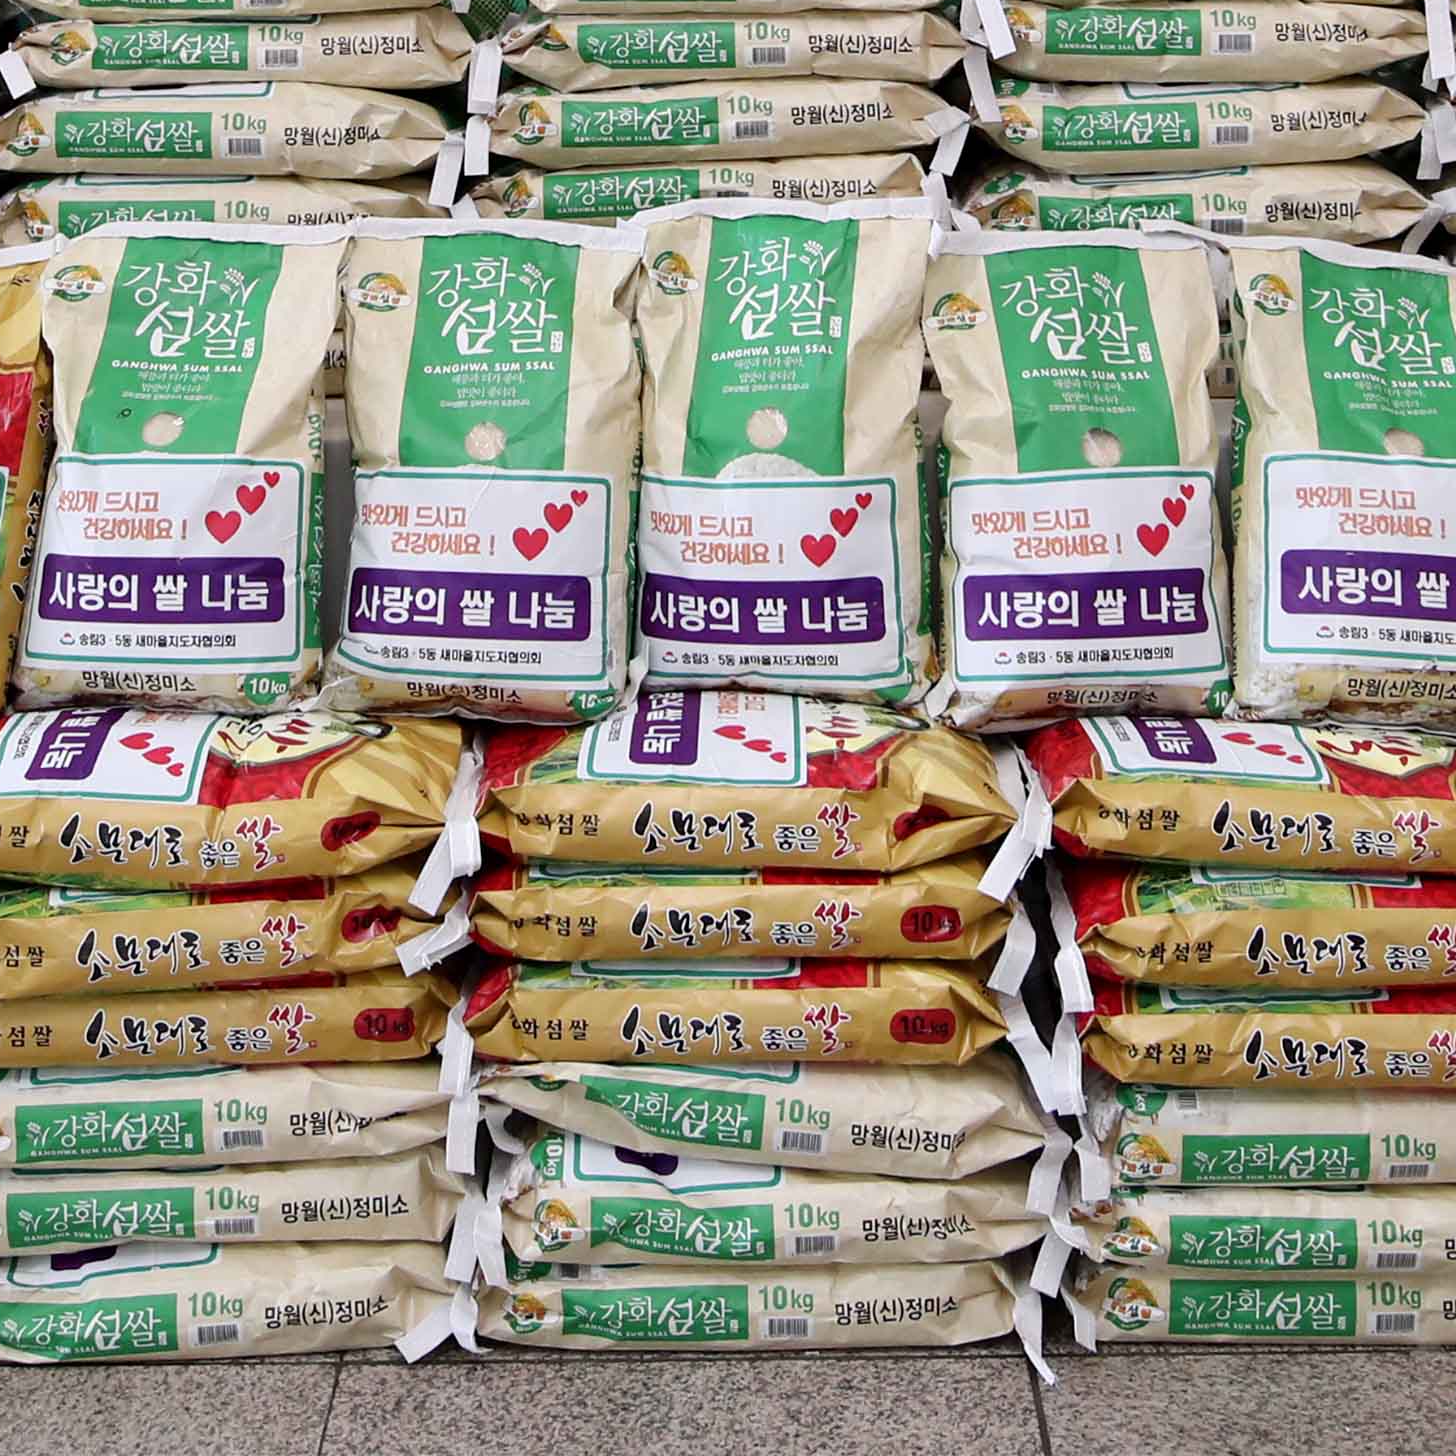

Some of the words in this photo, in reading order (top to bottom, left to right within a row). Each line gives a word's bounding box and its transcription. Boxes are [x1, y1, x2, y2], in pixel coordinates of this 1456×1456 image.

[725, 95, 774, 117] 10kg
[790, 102, 896, 126] 망월(신)정미소
[592, 104, 705, 145] 강화섬쌀
[426, 256, 516, 309] 강화
[714, 237, 797, 296] 강화
[441, 297, 559, 357] 섬쌀
[728, 280, 837, 341] 섬쌀
[423, 362, 488, 375] GANGHWA
[493, 362, 522, 373] SUM
[525, 360, 557, 372] SSAL
[710, 345, 771, 363] GANGHWA
[772, 344, 801, 356] SUM
[803, 343, 835, 355] SSAL
[1296, 486, 1354, 511] 맛있게
[1358, 487, 1417, 511] 드시고
[649, 510, 694, 536] 맛있게
[698, 513, 754, 538] 드시고
[1337, 511, 1433, 539] 건강하세요
[679, 538, 771, 565] 건강하세요
[48, 571, 140, 613] 사랑의
[152, 571, 189, 612] 쌀
[200, 571, 270, 613] 나눔
[1296, 565, 1402, 605] 사랑의
[1413, 569, 1451, 609] 쌀
[354, 583, 446, 626] 사랑의
[459, 586, 495, 627] 쌀
[507, 589, 577, 630] 나눔
[649, 590, 741, 633] 사랑의
[752, 592, 789, 633] 쌀
[800, 593, 869, 633] 나눔
[977, 589, 1081, 630] 사랑의
[1092, 588, 1129, 628] 쌀
[1139, 585, 1198, 626] 나눔
[81, 670, 198, 694] 망월(신)정미소
[775, 822, 821, 851] 좋은
[815, 802, 863, 858] 쌀
[44, 1196, 177, 1237] 강화섬쌀
[204, 1185, 261, 1213] 10kg
[280, 1196, 409, 1224] 망월(신)정미소
[598, 1295, 733, 1338] 강화섬쌀
[757, 1285, 815, 1313] 10kg
[834, 1296, 960, 1326] 망월(신)정미소
